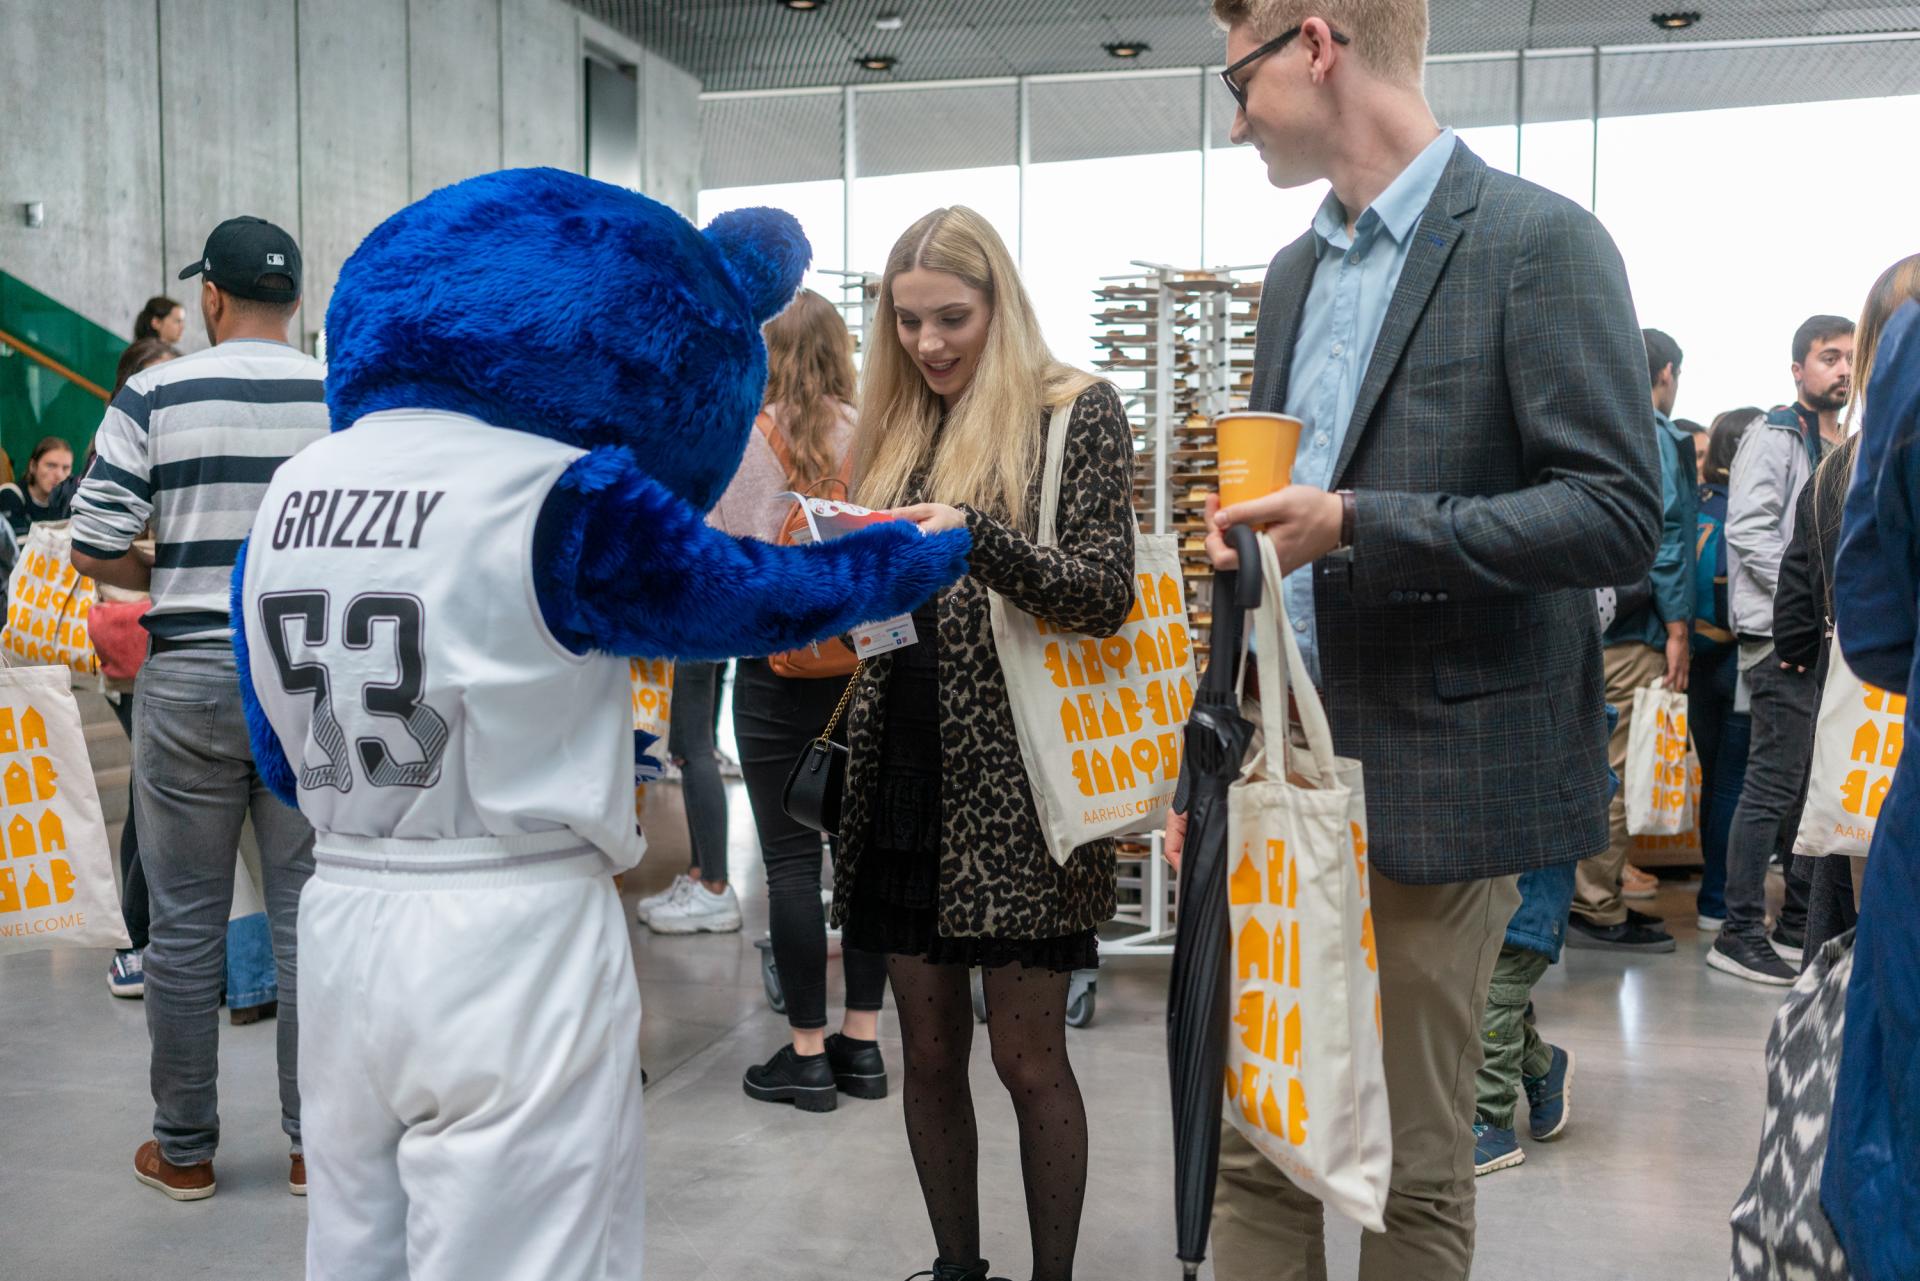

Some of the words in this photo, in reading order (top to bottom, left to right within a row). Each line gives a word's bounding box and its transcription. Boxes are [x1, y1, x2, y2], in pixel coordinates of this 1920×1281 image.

[272, 489, 446, 550] GRIZZLY
[1083, 803, 1134, 825] AARHUS
[1135, 796, 1160, 815] CITY
[0, 911, 87, 938] WELCOME
